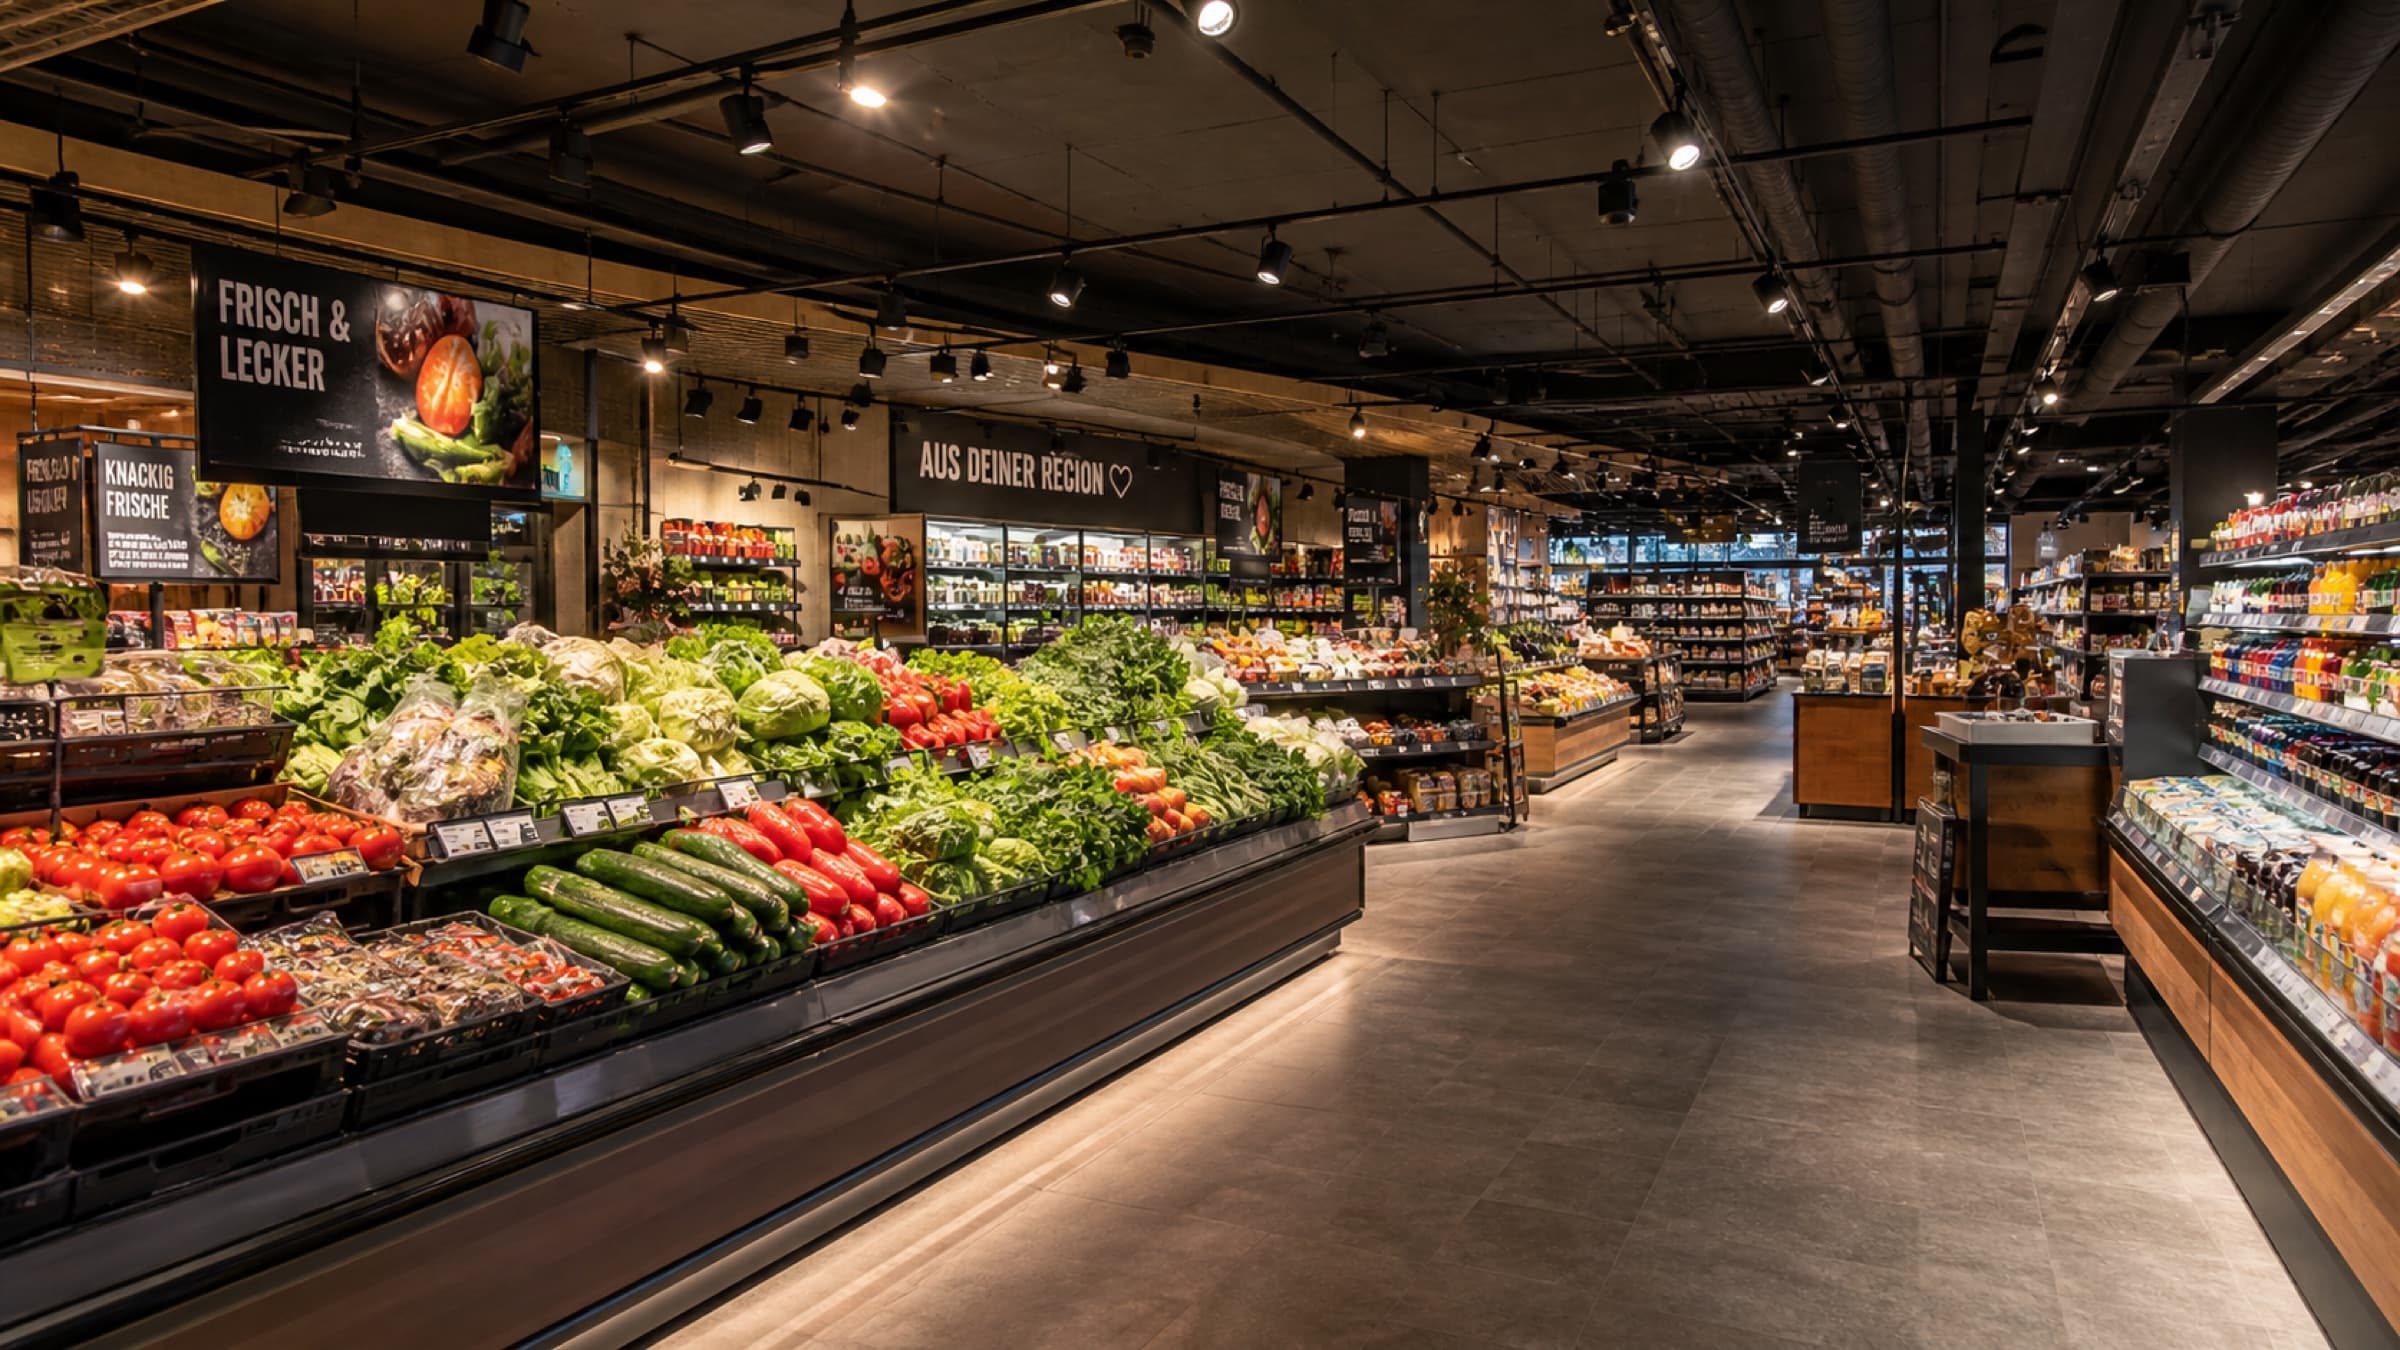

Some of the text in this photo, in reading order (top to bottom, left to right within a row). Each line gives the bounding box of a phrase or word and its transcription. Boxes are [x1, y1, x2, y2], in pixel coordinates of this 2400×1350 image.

[218, 278, 351, 344] FRISCH &
[220, 335, 326, 392] LECKER
[105, 458, 175, 490] KNACKIG
[919, 440, 961, 481] AUS
[967, 446, 1035, 489] DEINER
[105, 490, 171, 520] FRISCHE
